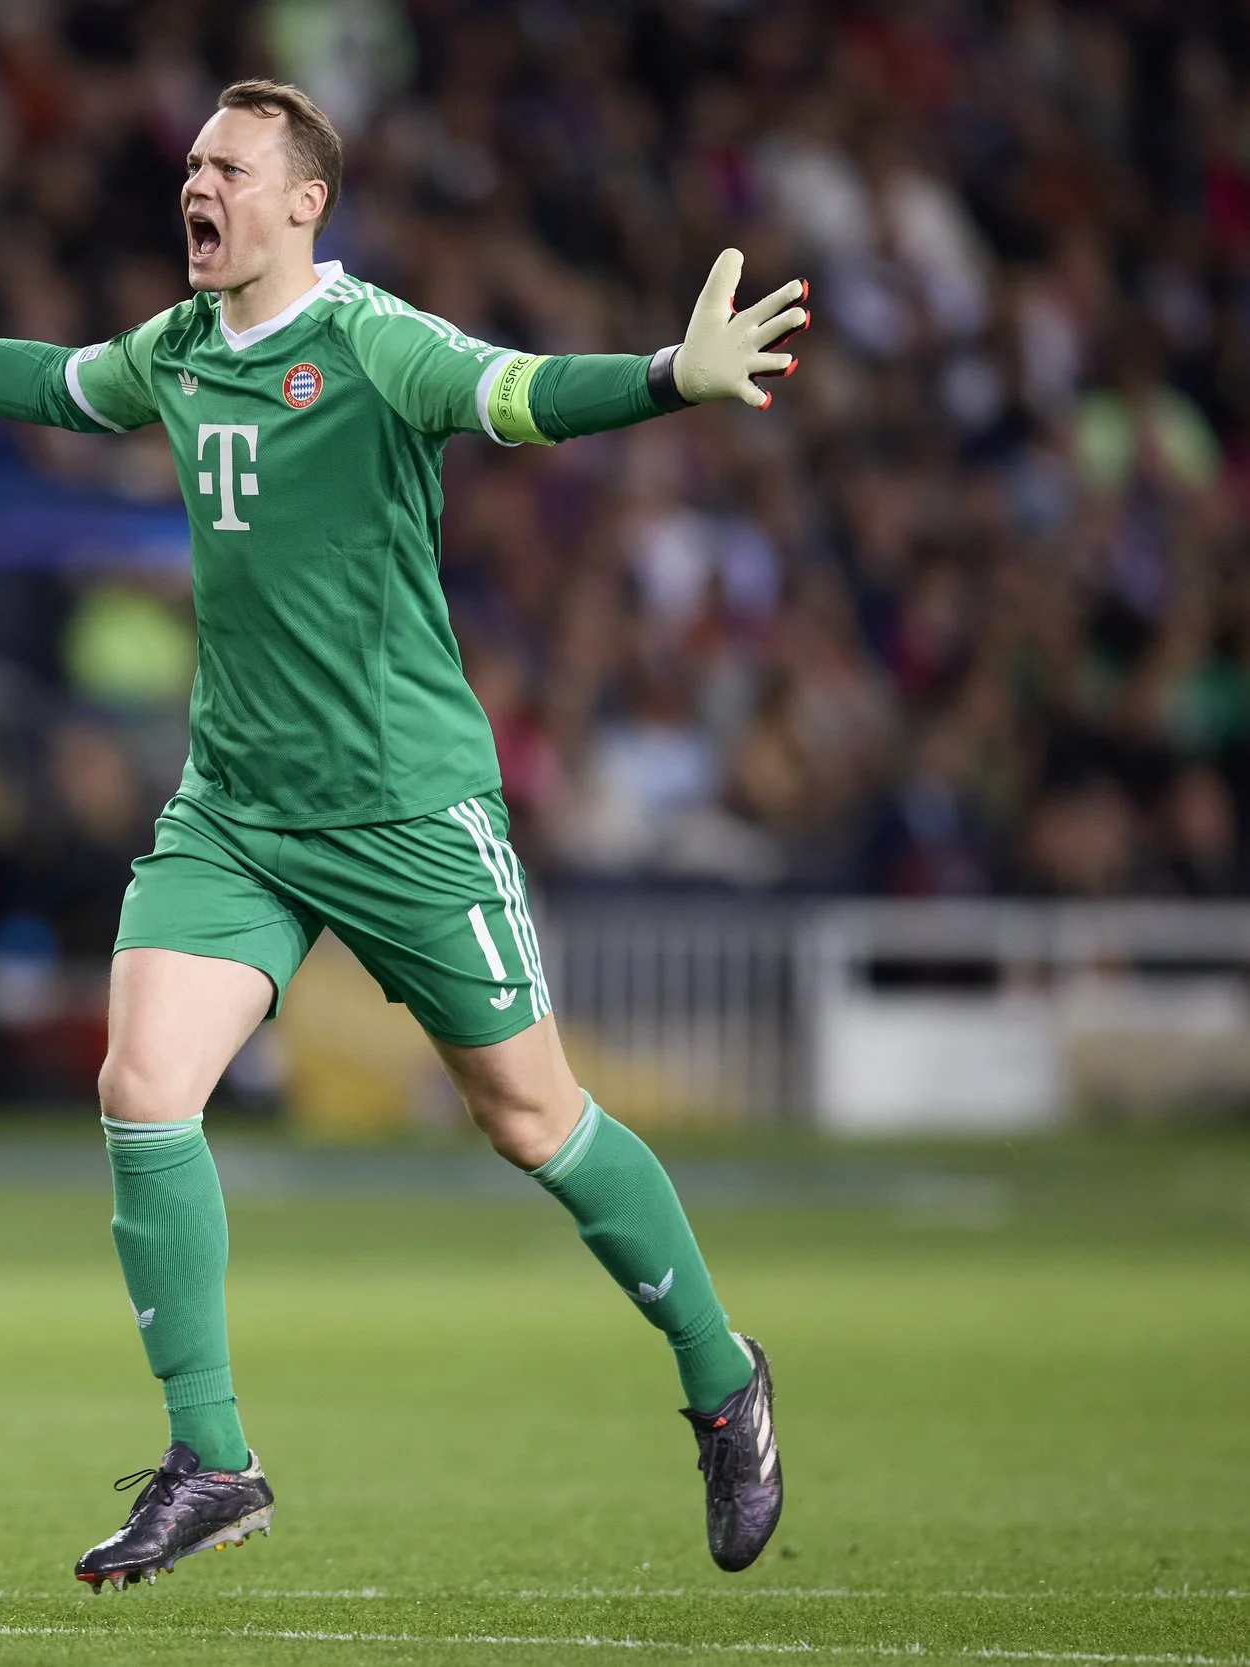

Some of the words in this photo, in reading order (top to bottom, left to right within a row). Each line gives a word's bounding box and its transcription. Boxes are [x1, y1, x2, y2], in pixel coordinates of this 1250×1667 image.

[297, 365, 319, 379] BAYERN
[501, 357, 530, 401] RESPEC
[197, 423, 259, 531] T
[467, 903, 507, 982] 1
